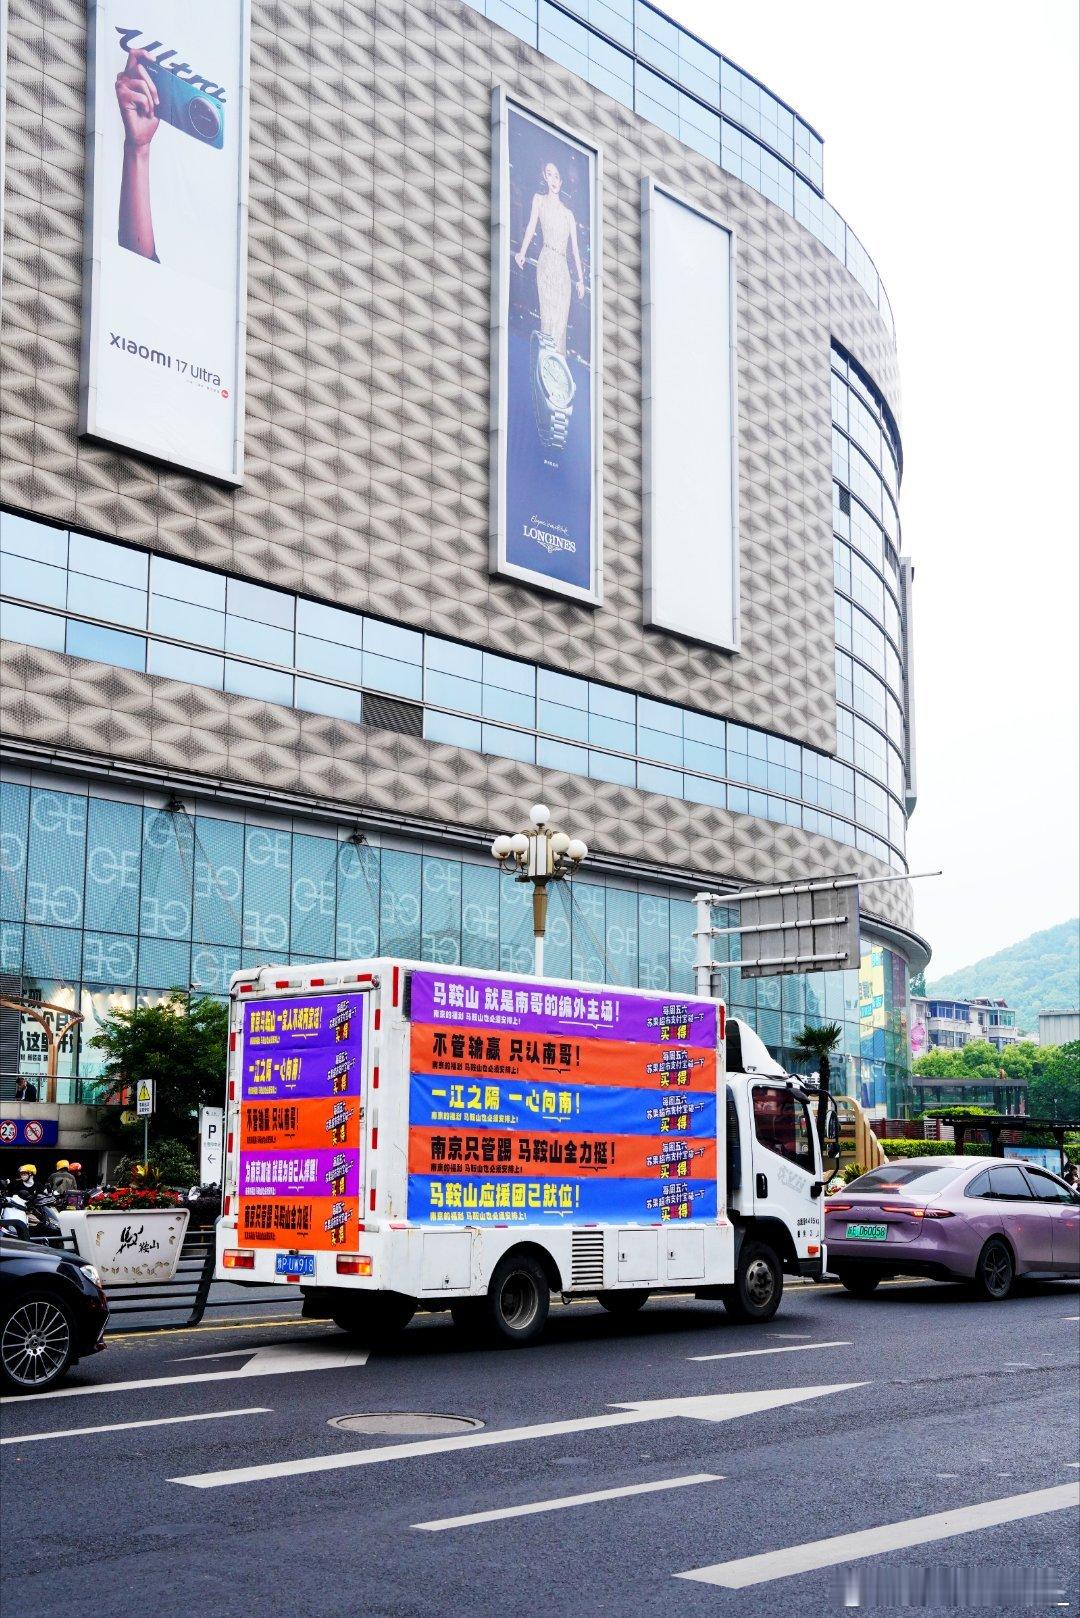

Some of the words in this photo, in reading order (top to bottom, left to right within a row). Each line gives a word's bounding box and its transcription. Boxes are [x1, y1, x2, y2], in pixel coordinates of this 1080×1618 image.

[175, 359, 188, 373] 17
[190, 364, 221, 386] Ultra
[523, 525, 576, 553] LONGINES
[434, 981, 479, 1009] 马鞍山
[433, 1032, 501, 1060] 不管输赢
[431, 1085, 500, 1110] 一江之隔
[208, 1124, 217, 1139] P
[431, 1135, 512, 1162] 南京只管踢
